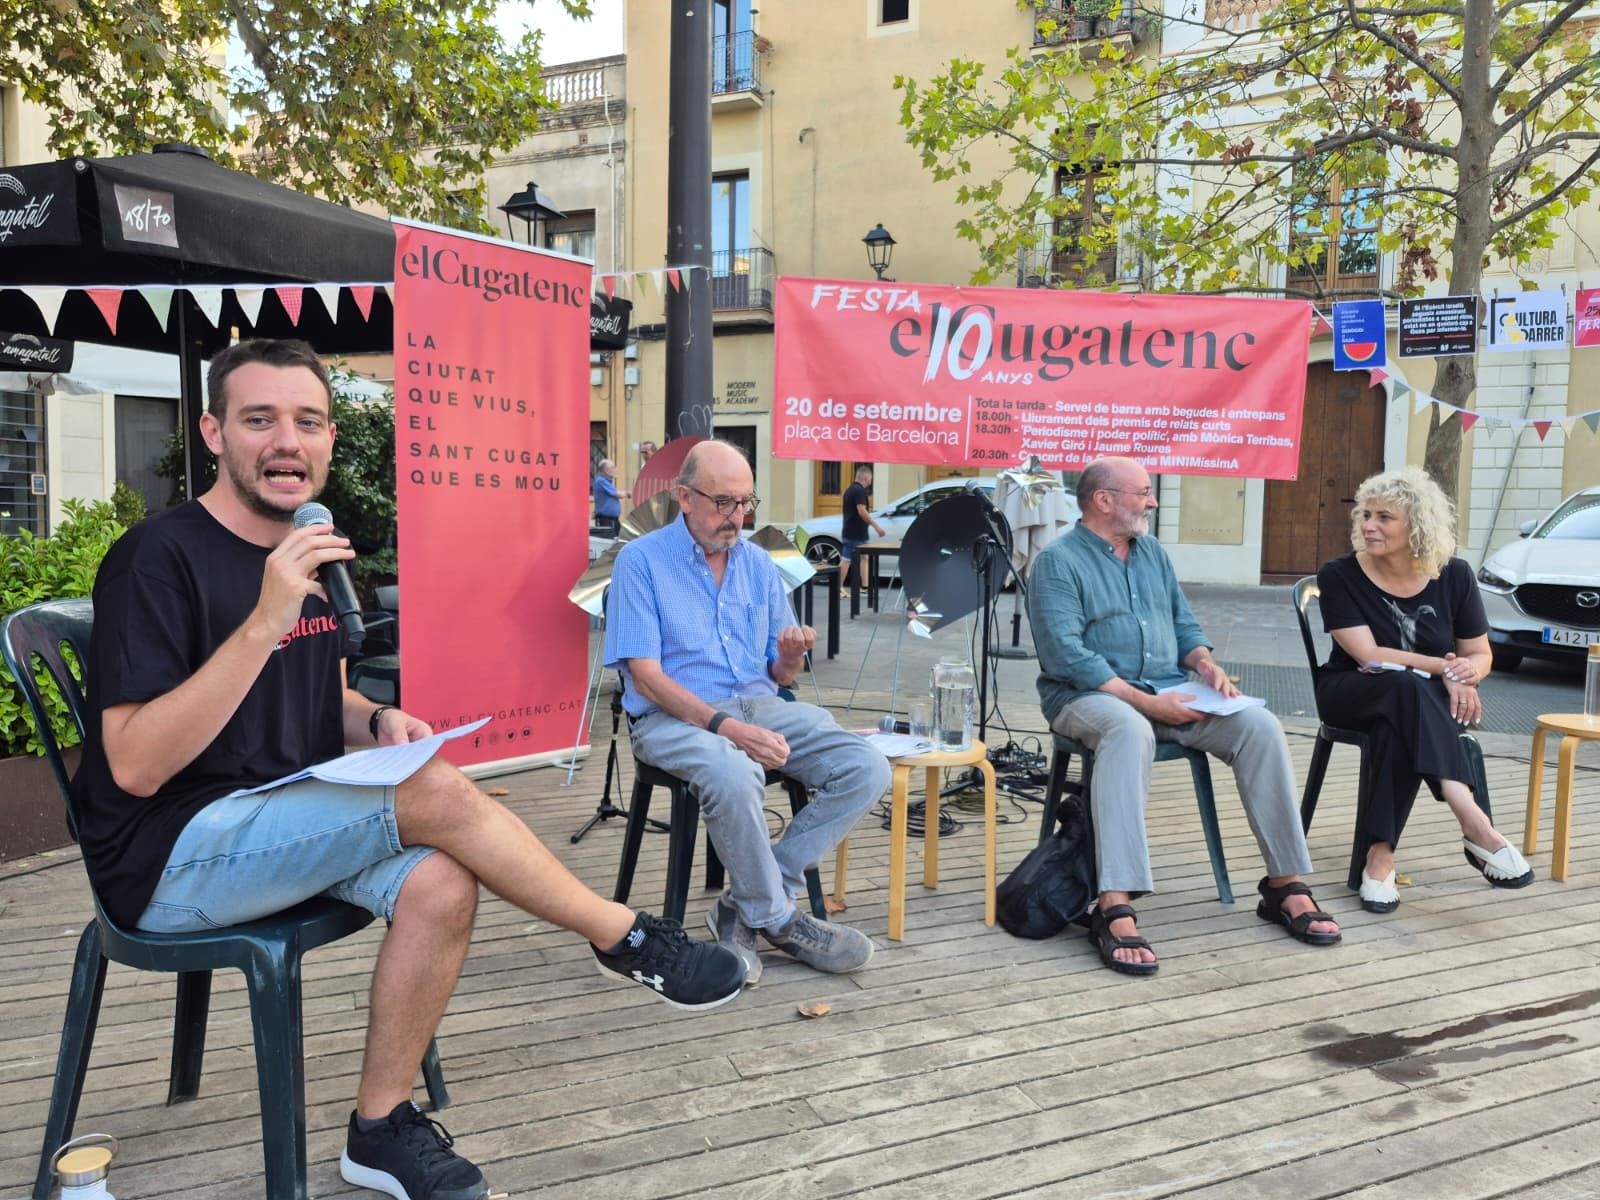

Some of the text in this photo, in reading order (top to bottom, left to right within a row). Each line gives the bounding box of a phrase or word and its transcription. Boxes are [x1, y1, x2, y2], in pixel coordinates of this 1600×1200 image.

[125, 198, 171, 232] 18/70
[401, 245, 584, 308] elCugatenc
[811, 284, 922, 313] FESTA
[407, 332, 436, 350] LA
[922, 305, 993, 385] 10
[408, 360, 495, 384] CIUTAT
[980, 371, 1033, 385] ANYS
[409, 388, 535, 417] QUE VIUS,
[785, 397, 962, 422] 20 de setembre
[976, 398, 999, 409] Tota
[1003, 399, 1012, 409] la
[1016, 400, 1045, 410] tarda
[1056, 401, 1091, 413] Servei
[1094, 403, 1108, 413] de
[1112, 403, 1141, 415] barra
[1145, 405, 1169, 415] amb
[1173, 406, 1218, 419] begudes
[1228, 408, 1285, 421] entrepans
[410, 415, 437, 431] EL
[784, 420, 959, 445] plaça de Barcelona
[976, 411, 1012, 421] 18.00h
[1021, 412, 1083, 425] Lliurament
[1085, 415, 1109, 426] dels
[1112, 417, 1150, 428] premis
[1153, 418, 1167, 428] de
[1170, 420, 1199, 430] relats
[1201, 421, 1231, 431] curts
[975, 424, 1011, 434] 18.30h
[1097, 429, 1130, 440] poder
[1172, 431, 1198, 442] amb
[1200, 432, 1243, 444] Mònica
[410, 442, 560, 466] SANT CUGAT
[971, 449, 1009, 459] 20.30h
[1065, 453, 1080, 463] de
[1021, 438, 1058, 449] Xavier
[1061, 439, 1085, 451] Giró
[1094, 441, 1131, 452] Jaume
[1133, 442, 1171, 454] Roures
[411, 469, 560, 491] QUE ES MOU
[1553, 631, 1589, 645] 4121
